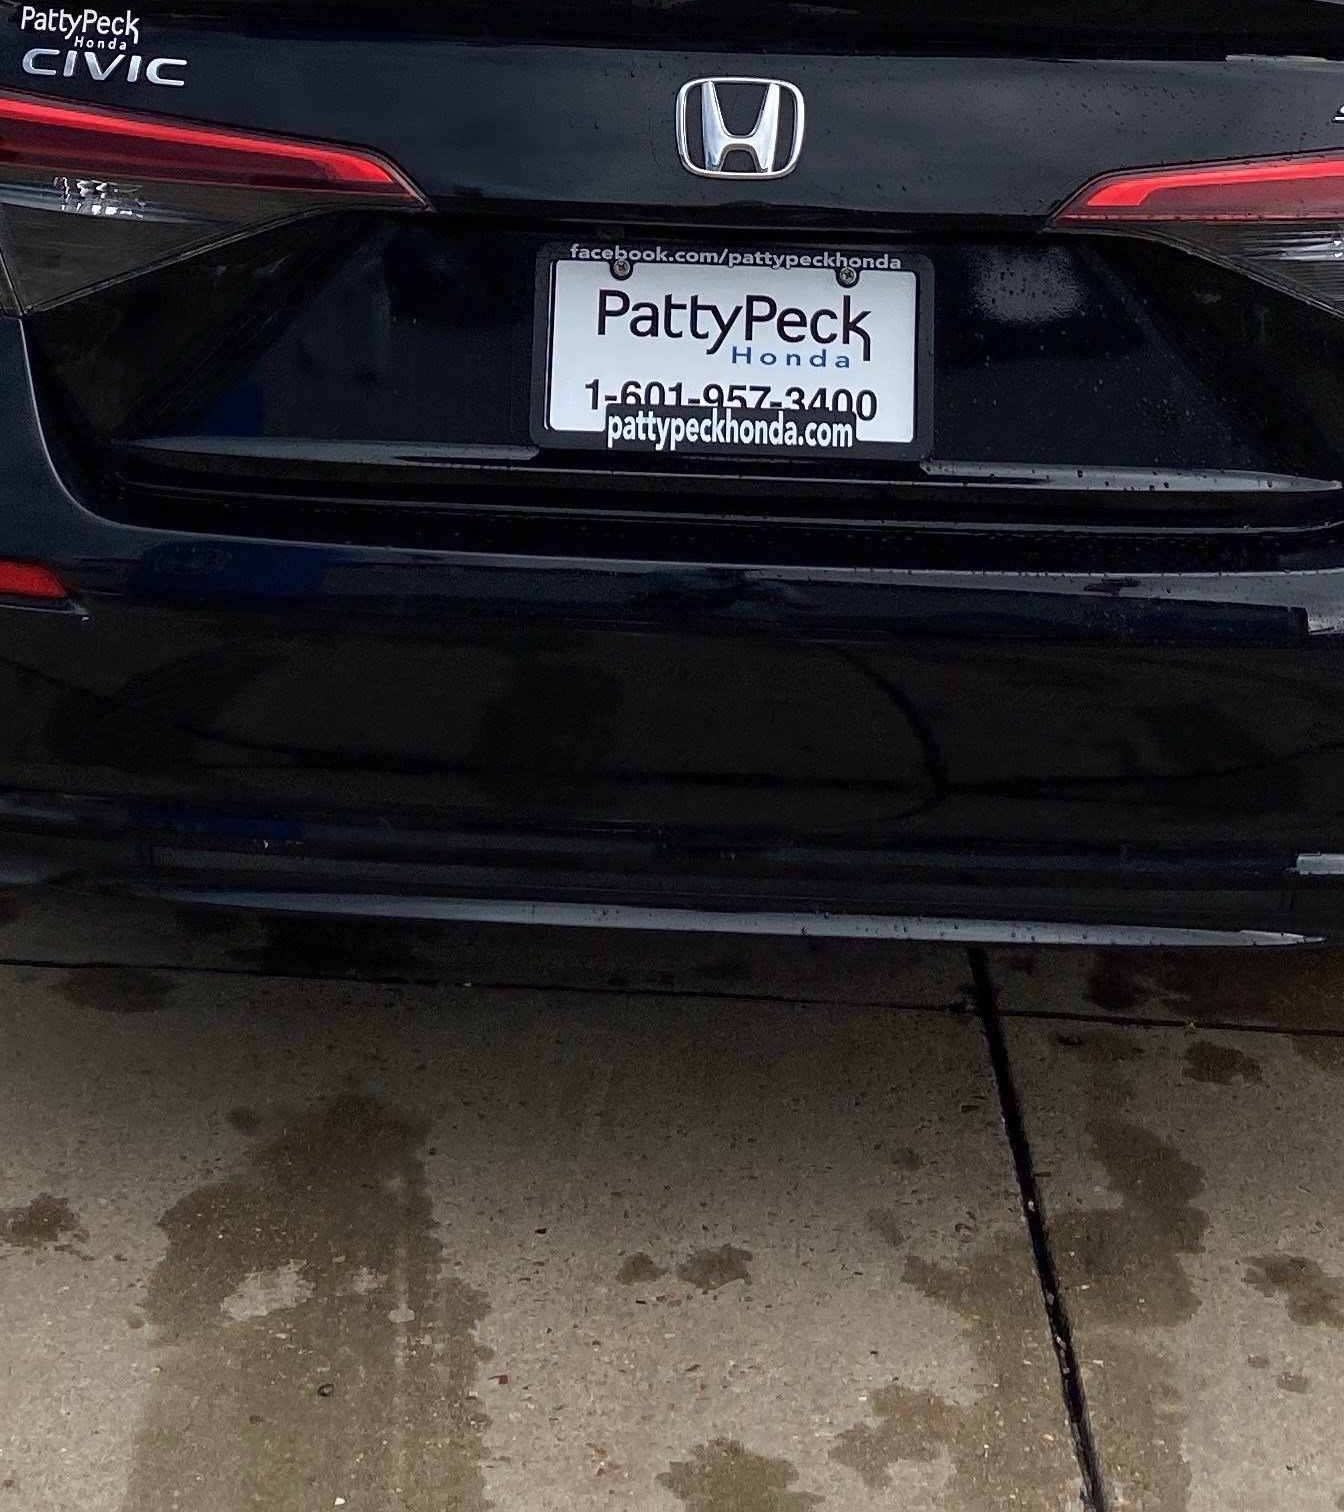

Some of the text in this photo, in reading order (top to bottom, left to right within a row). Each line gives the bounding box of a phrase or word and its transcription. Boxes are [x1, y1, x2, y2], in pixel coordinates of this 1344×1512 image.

[20, 5, 140, 45] PattyPeck
[73, 35, 128, 51] Honda
[22, 47, 188, 86] CIVIC
[569, 243, 903, 271] facebook.com/pattypeckhonda
[597, 288, 872, 362] PattyPeck
[731, 345, 851, 369] Honda
[584, 378, 878, 422] 1-601-957-3400
[606, 407, 853, 452] pattypeckhonda.com
